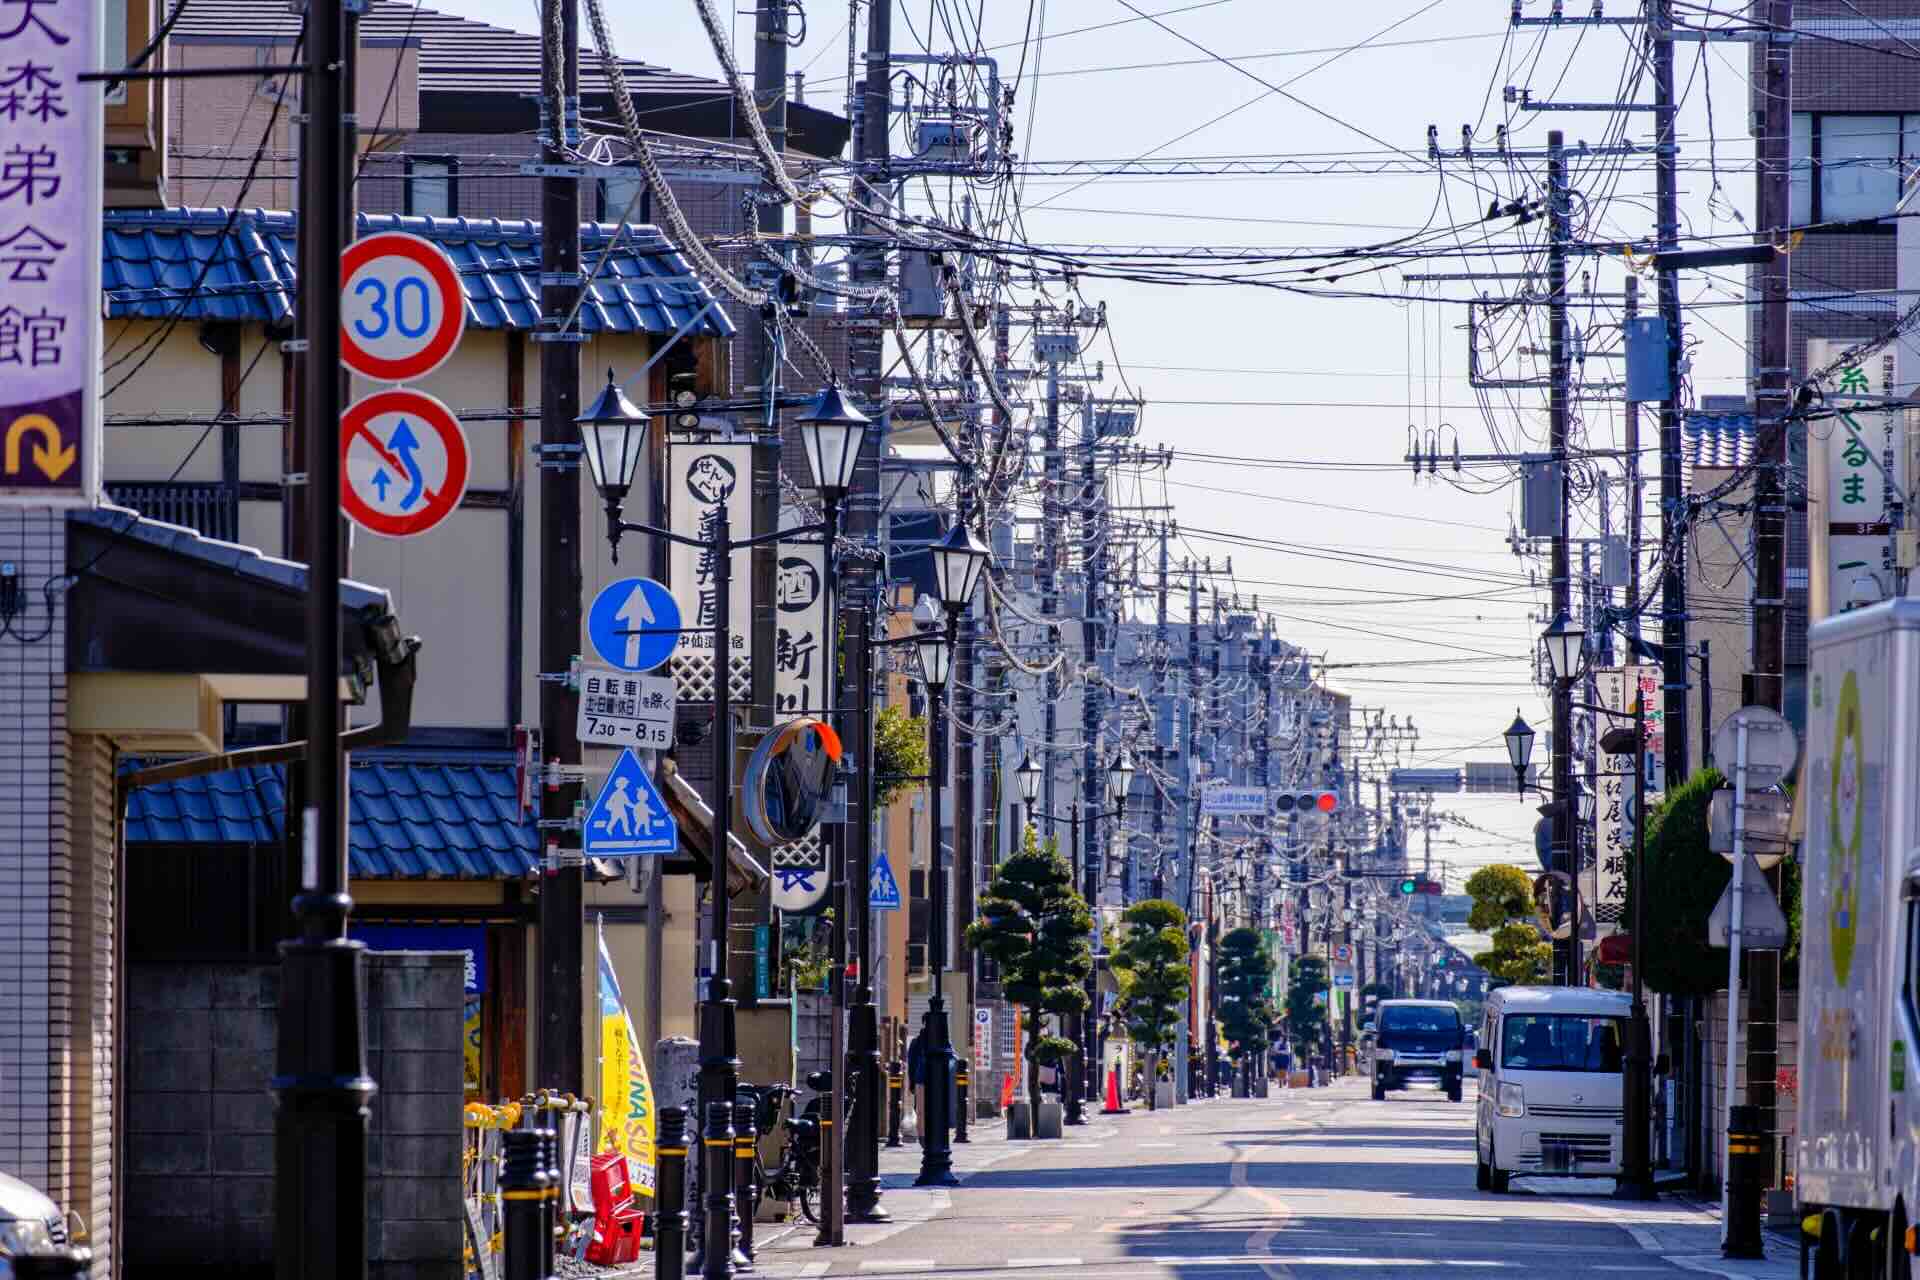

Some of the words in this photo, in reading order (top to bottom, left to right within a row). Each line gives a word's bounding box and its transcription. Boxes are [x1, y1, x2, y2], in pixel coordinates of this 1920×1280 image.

[354, 277, 431, 340] 30
[587, 676, 638, 696] 自転車
[642, 692, 671, 711] を除く
